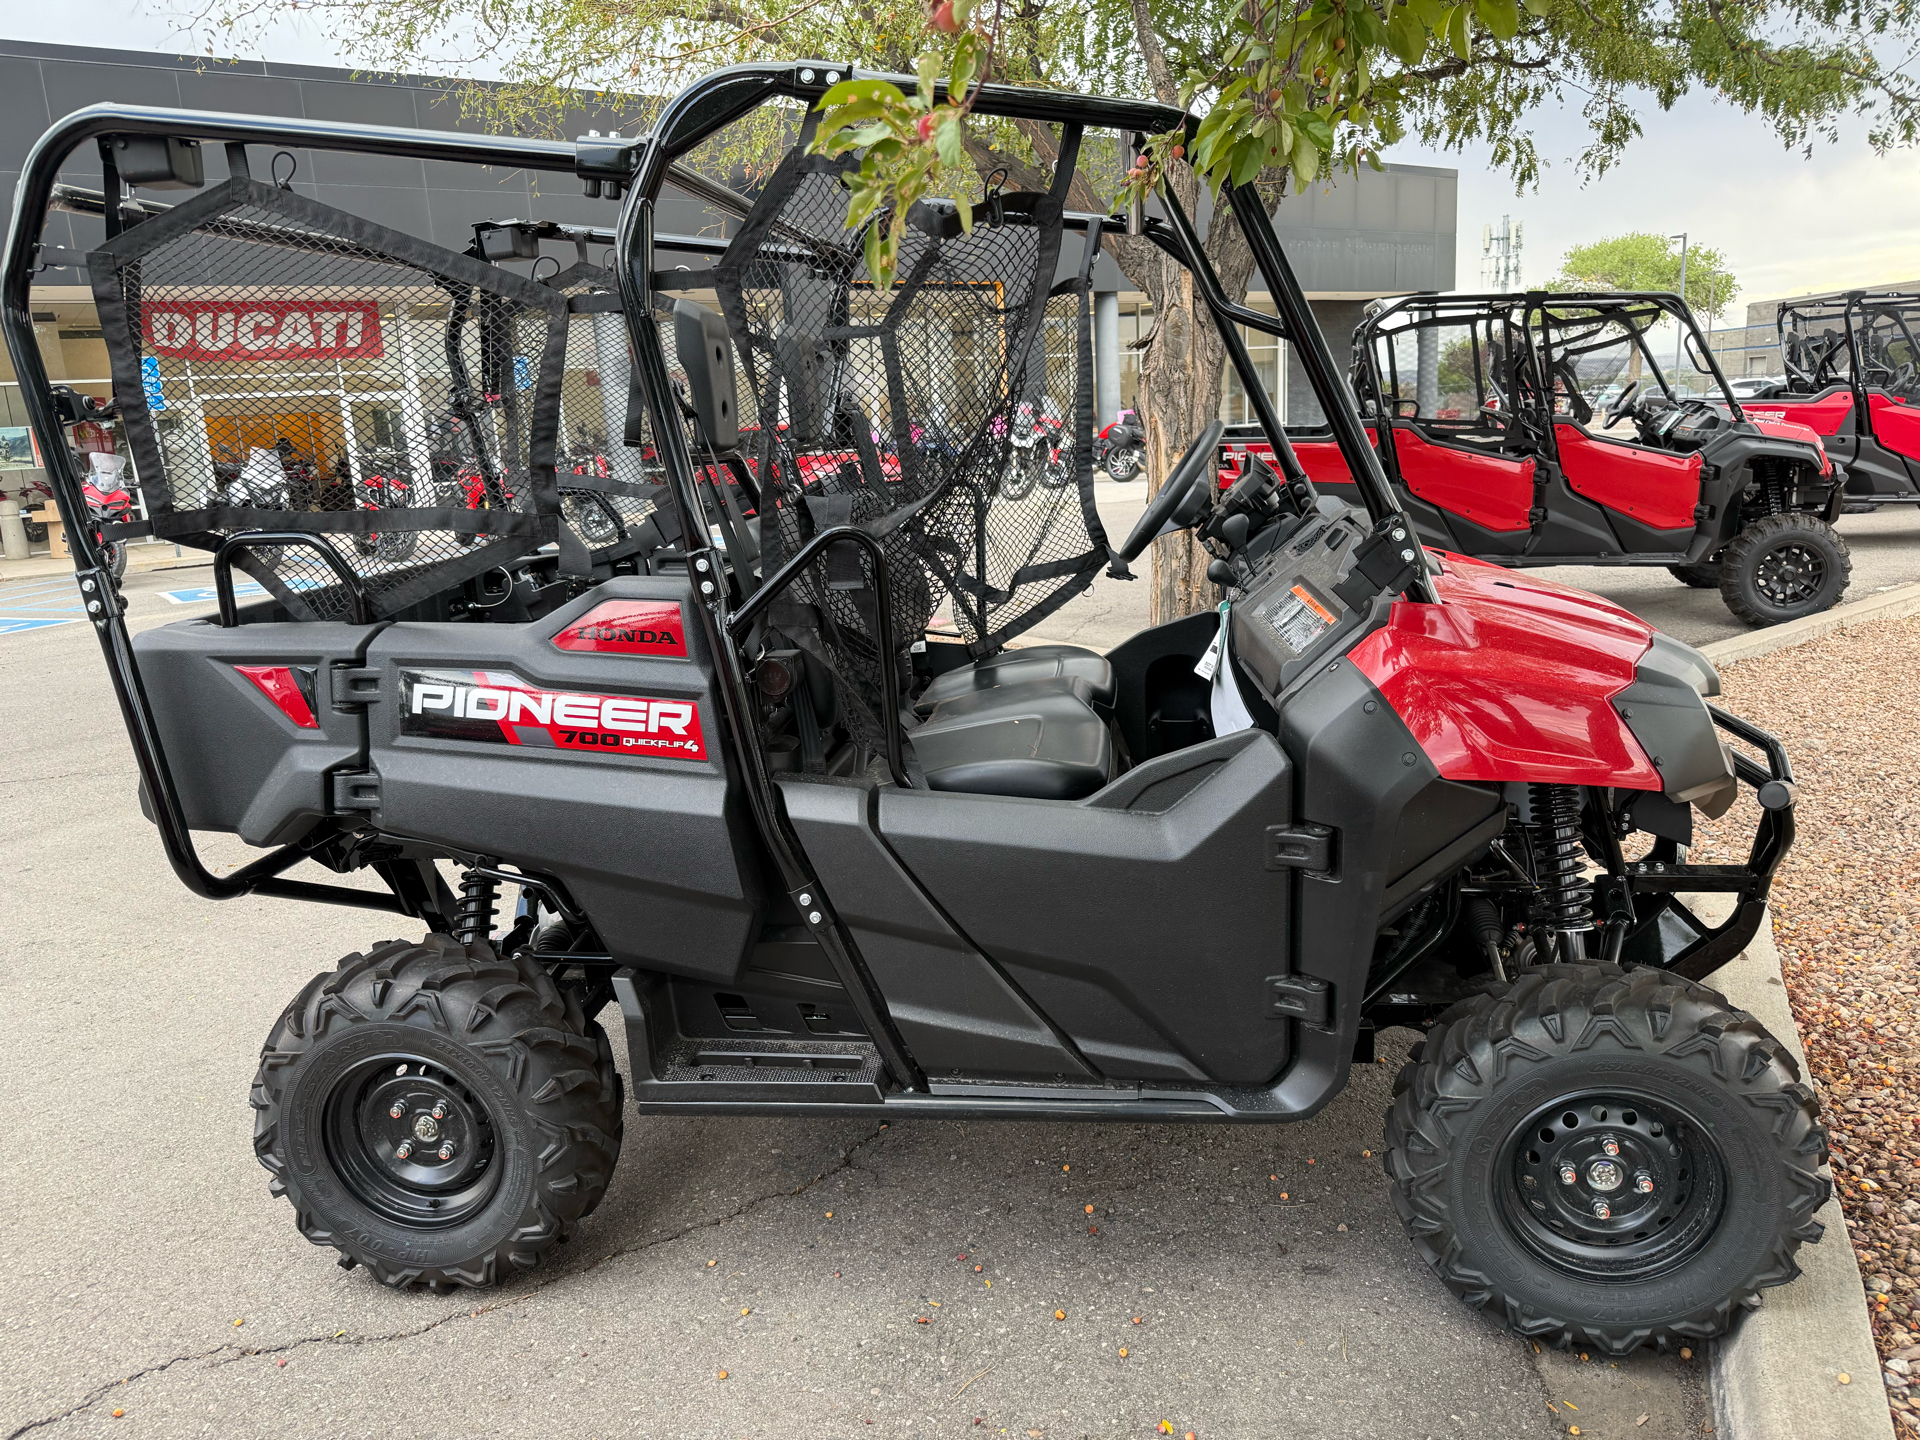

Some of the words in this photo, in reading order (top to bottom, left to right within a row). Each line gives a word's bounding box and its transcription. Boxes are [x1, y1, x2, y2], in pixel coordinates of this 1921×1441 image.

[151, 311, 364, 351] DUCATI
[577, 627, 678, 645] HONDA
[412, 683, 693, 735] PIONEER
[558, 729, 620, 747] 700
